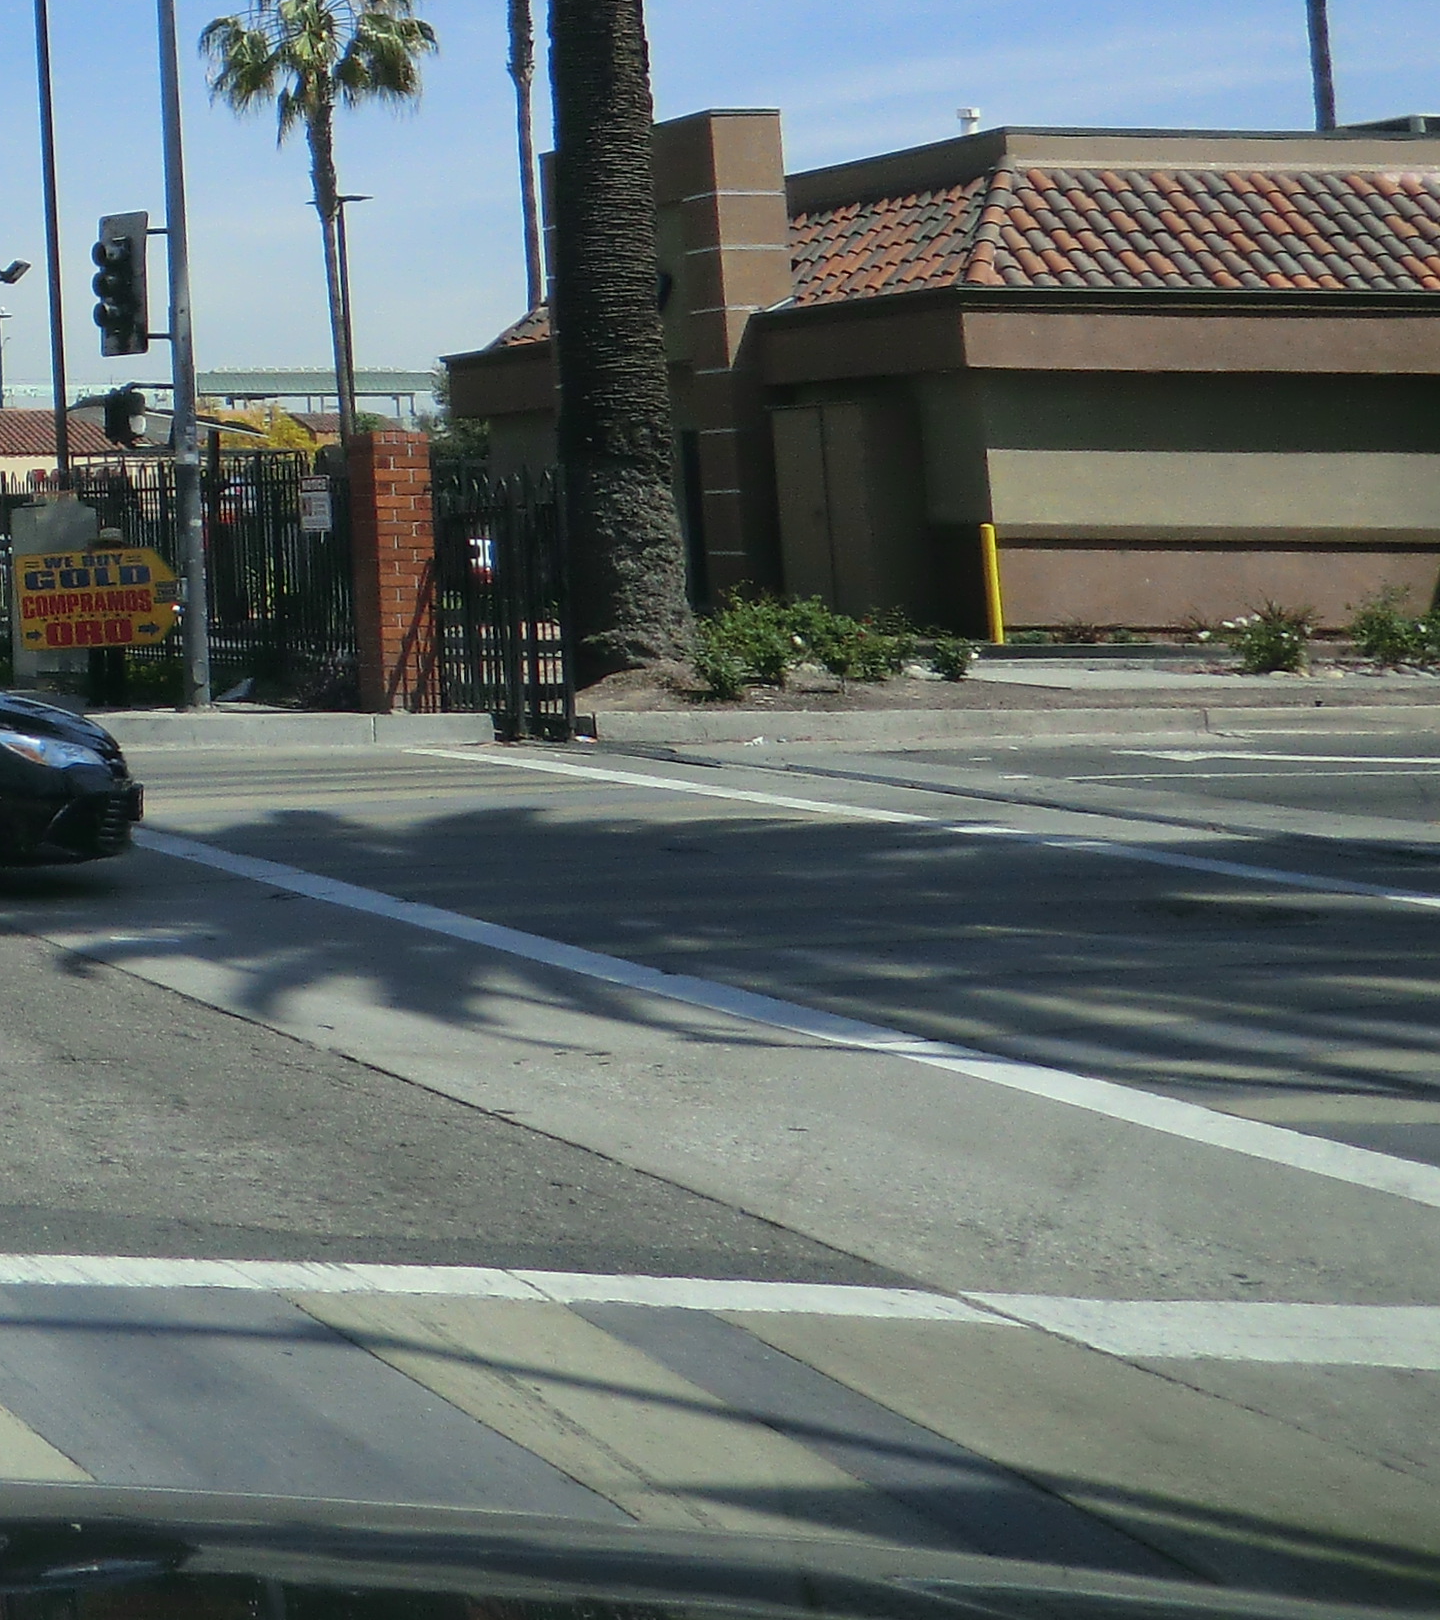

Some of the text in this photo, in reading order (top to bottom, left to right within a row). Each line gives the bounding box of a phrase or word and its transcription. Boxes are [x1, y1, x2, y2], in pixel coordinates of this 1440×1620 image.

[44, 553, 123, 569] WE BUY
[25, 566, 151, 591] GOLD
[23, 589, 152, 619] COMPRAMOS
[46, 618, 133, 646] ORO
